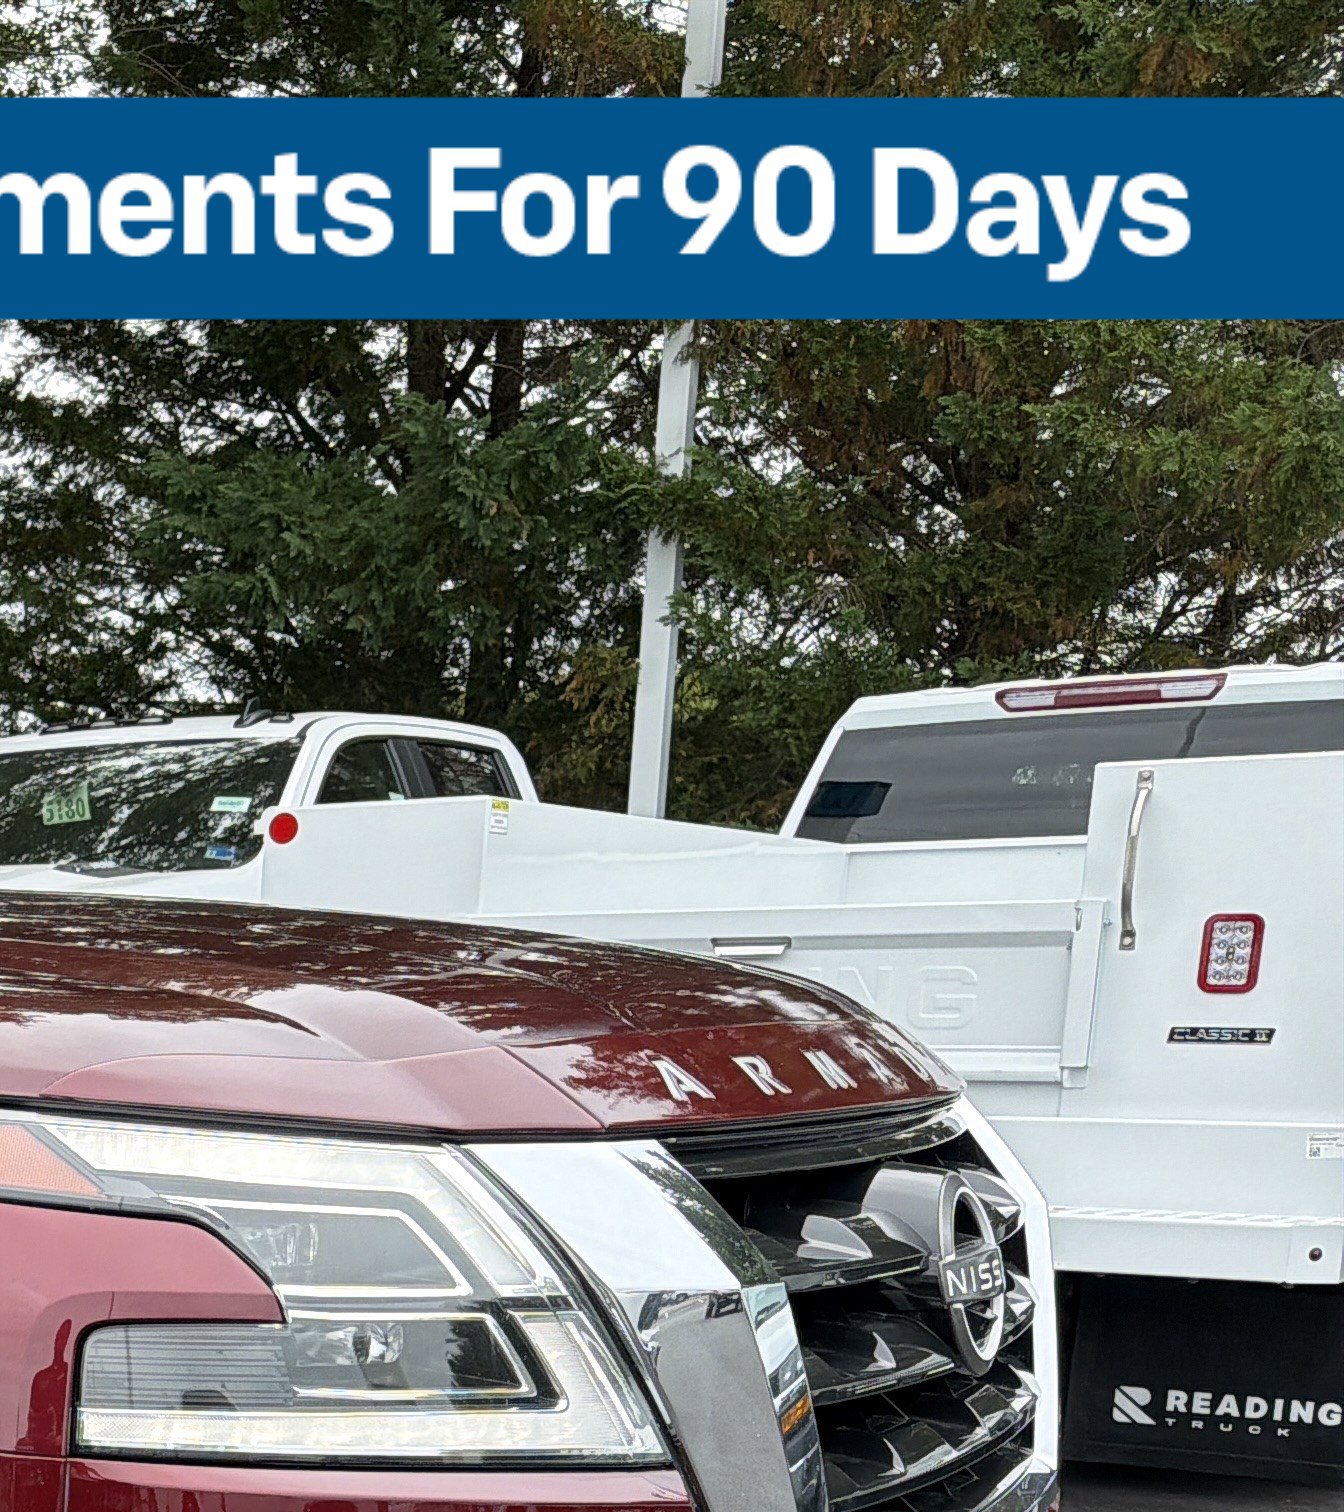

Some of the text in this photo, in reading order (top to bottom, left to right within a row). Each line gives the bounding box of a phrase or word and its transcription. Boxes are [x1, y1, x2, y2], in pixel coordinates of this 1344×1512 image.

[945, 1258, 1004, 1298] NISS
[1165, 1389, 1344, 1426] READING
[1165, 1417, 1291, 1438] TRUCK
